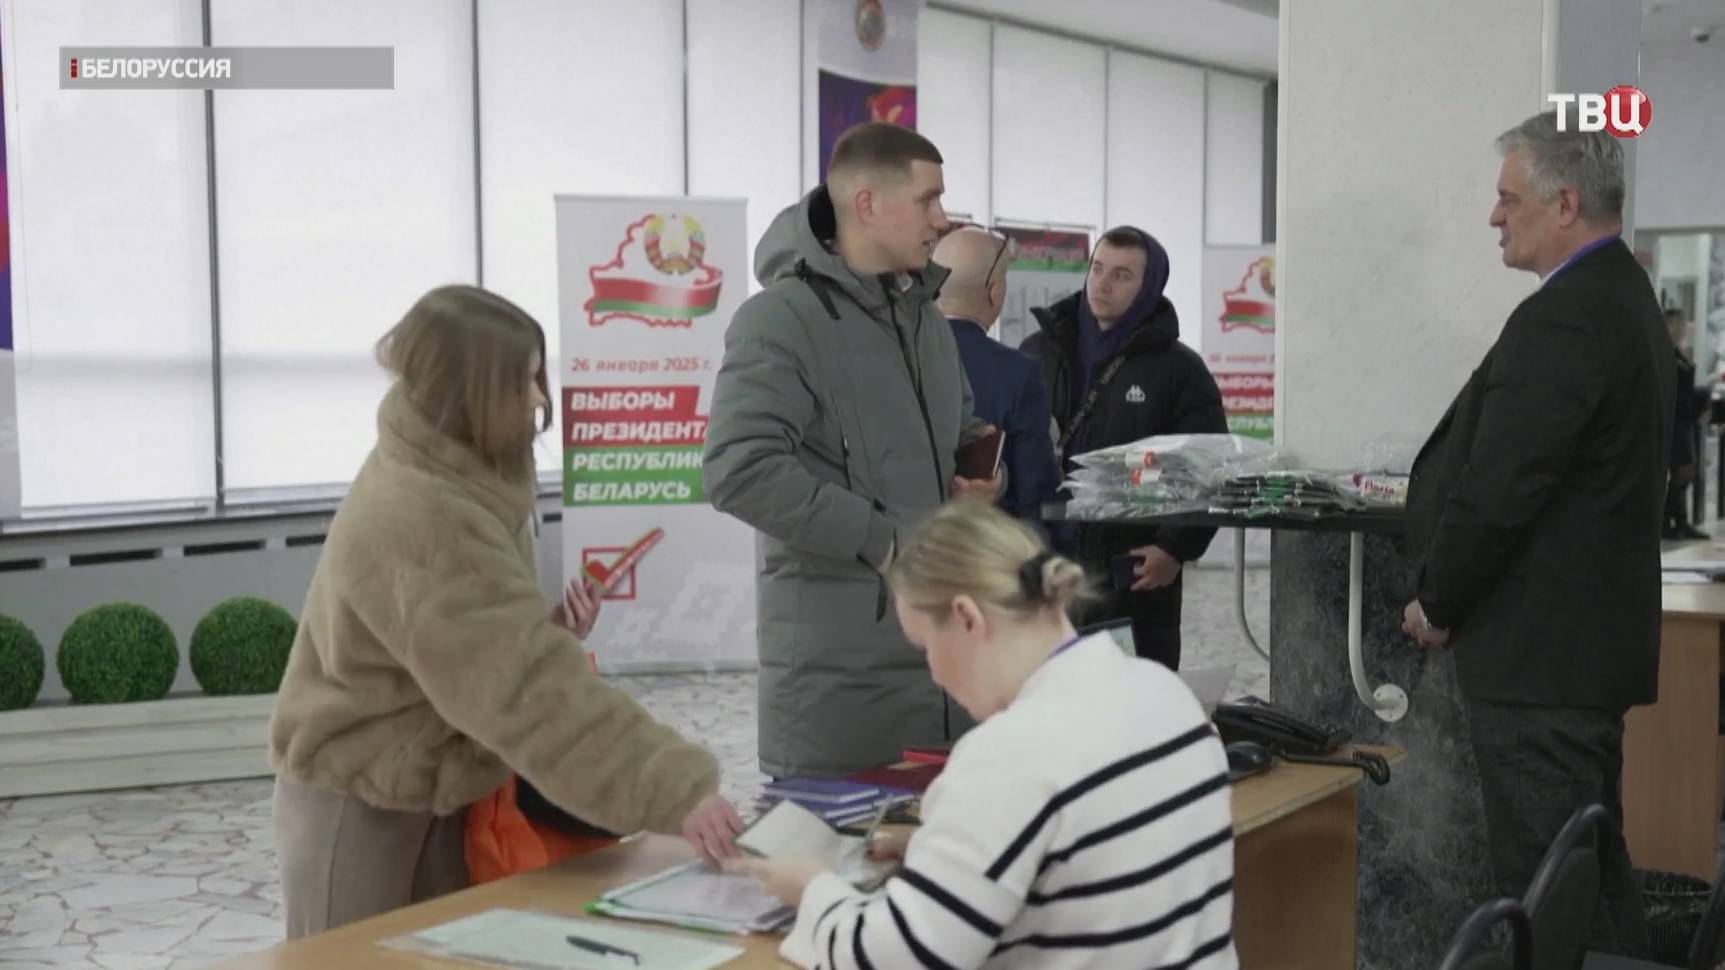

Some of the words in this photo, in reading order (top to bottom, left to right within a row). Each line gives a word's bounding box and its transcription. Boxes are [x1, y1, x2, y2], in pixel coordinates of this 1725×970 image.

[571, 358, 590, 372] 26
[596, 359, 659, 373] января
[664, 357, 699, 371] 2025
[571, 391, 675, 411] ВЫБОРЫ
[573, 482, 691, 501] БЕЛАРУСЬ
